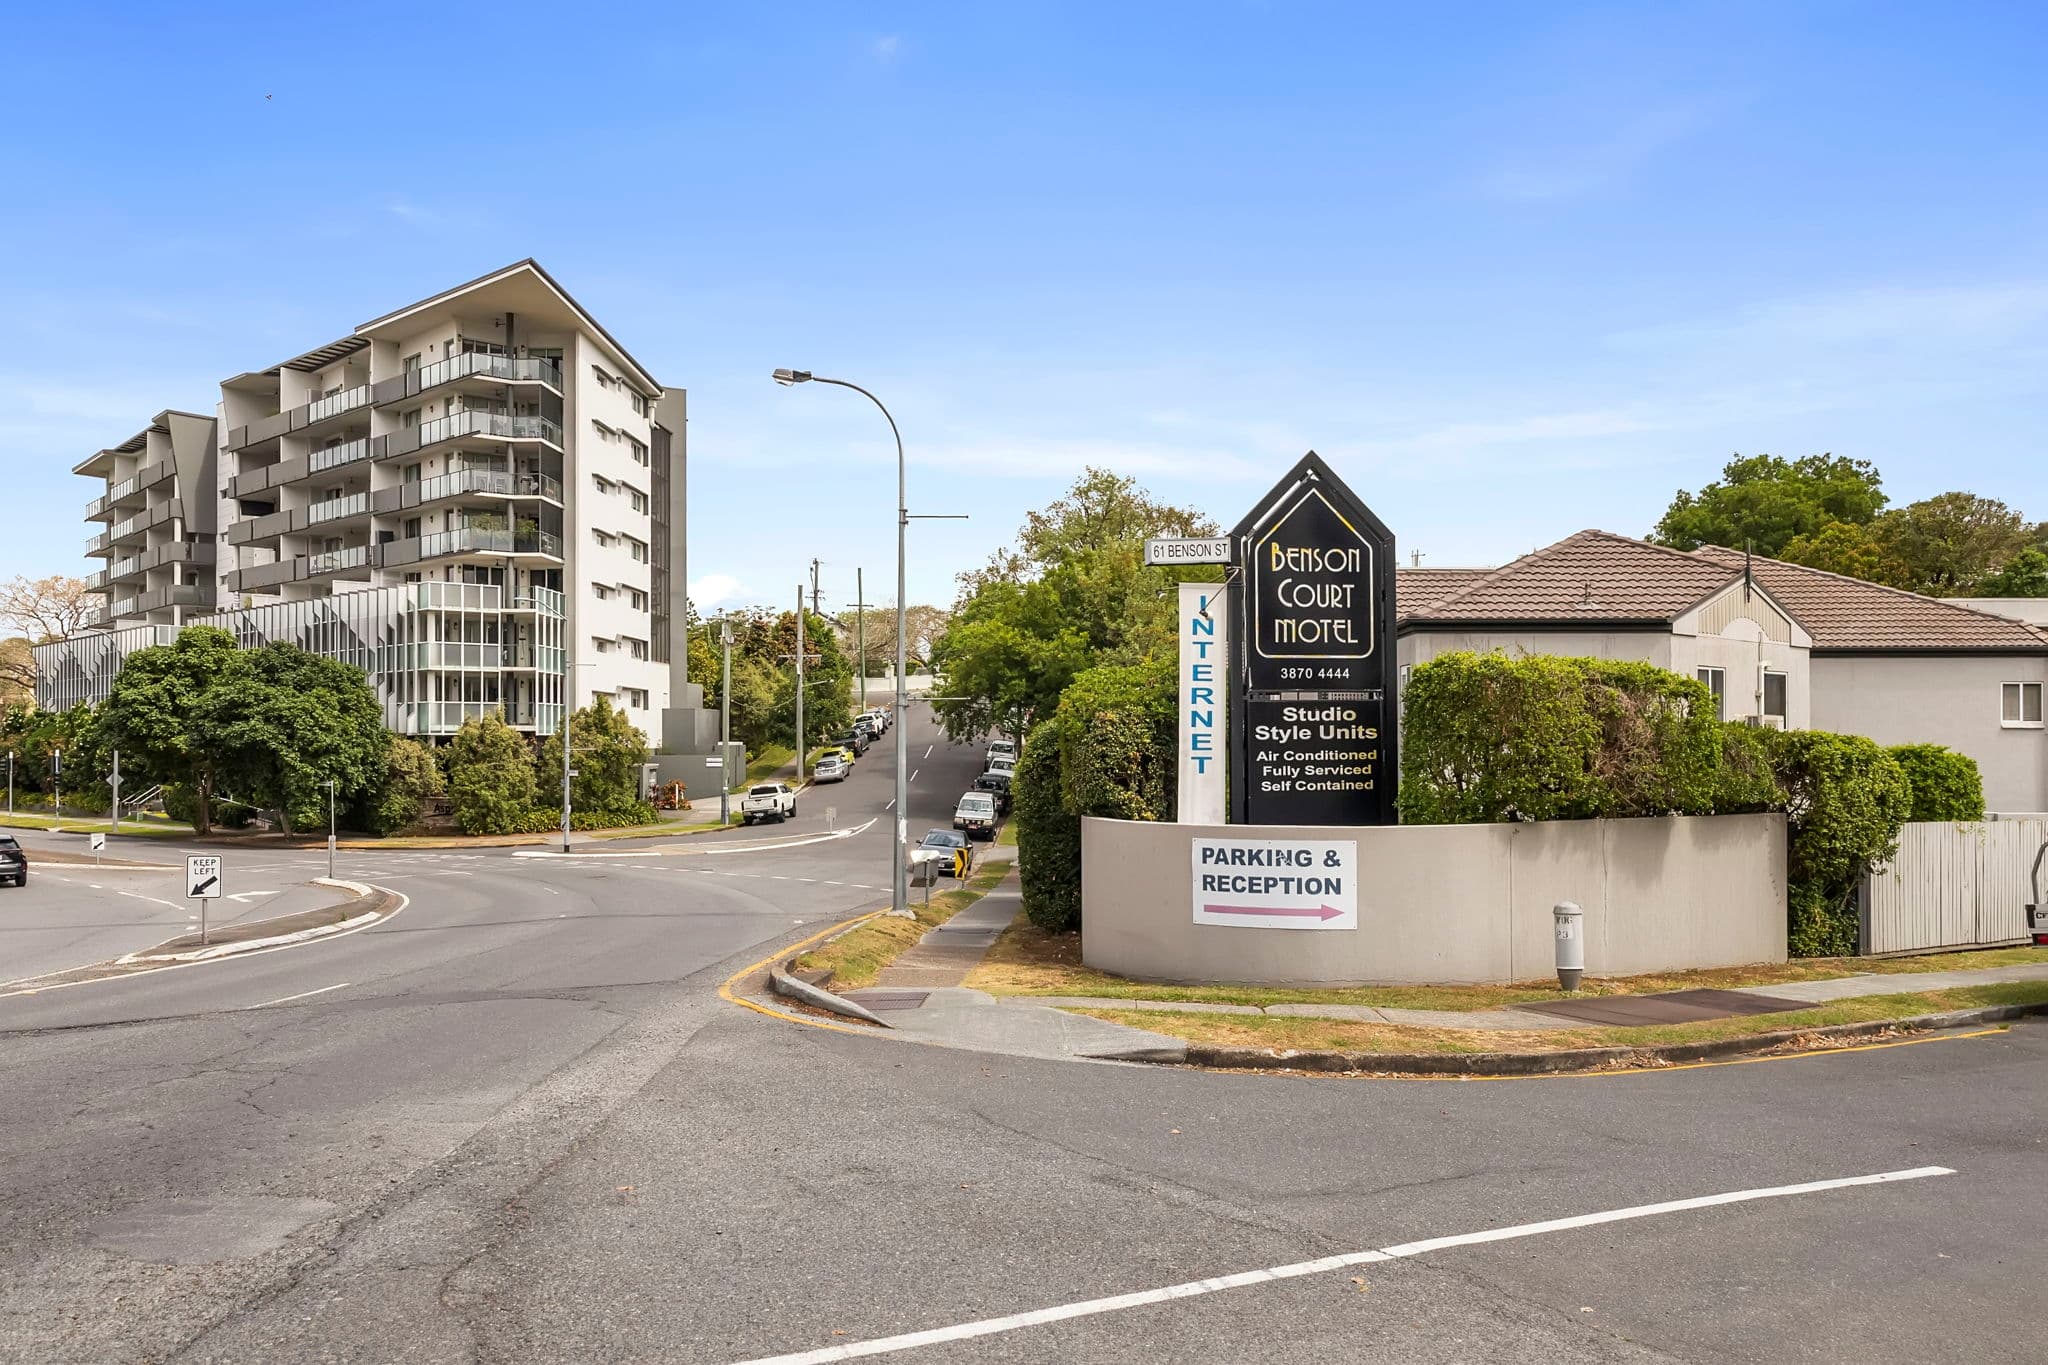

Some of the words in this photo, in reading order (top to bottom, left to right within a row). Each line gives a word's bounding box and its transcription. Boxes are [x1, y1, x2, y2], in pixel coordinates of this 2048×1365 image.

[1153, 545, 1165, 558] 61
[1168, 543, 1212, 557] BENSON
[1215, 543, 1228, 556] ST
[1271, 542, 1360, 573] BENSON
[1277, 578, 1355, 608] COURT
[1274, 619, 1358, 644] MOTEL
[1280, 668, 1313, 680] 3870
[1318, 668, 1350, 680] 4444
[1191, 595, 1214, 774] INTERNET
[1282, 706, 1357, 722] Studio
[1255, 725, 1312, 744] Style
[1319, 725, 1378, 740] Units
[1256, 750, 1278, 762] Air
[1283, 749, 1378, 761] Conditioned
[1262, 765, 1300, 778] Fully
[1304, 764, 1372, 776] Serviced
[1261, 780, 1291, 792] Self
[1295, 779, 1374, 791] Contained
[193, 859, 217, 867] KEEP
[1201, 847, 1313, 867] PARKING
[1323, 849, 1342, 867] &
[1202, 874, 1342, 895] RECEPTION
